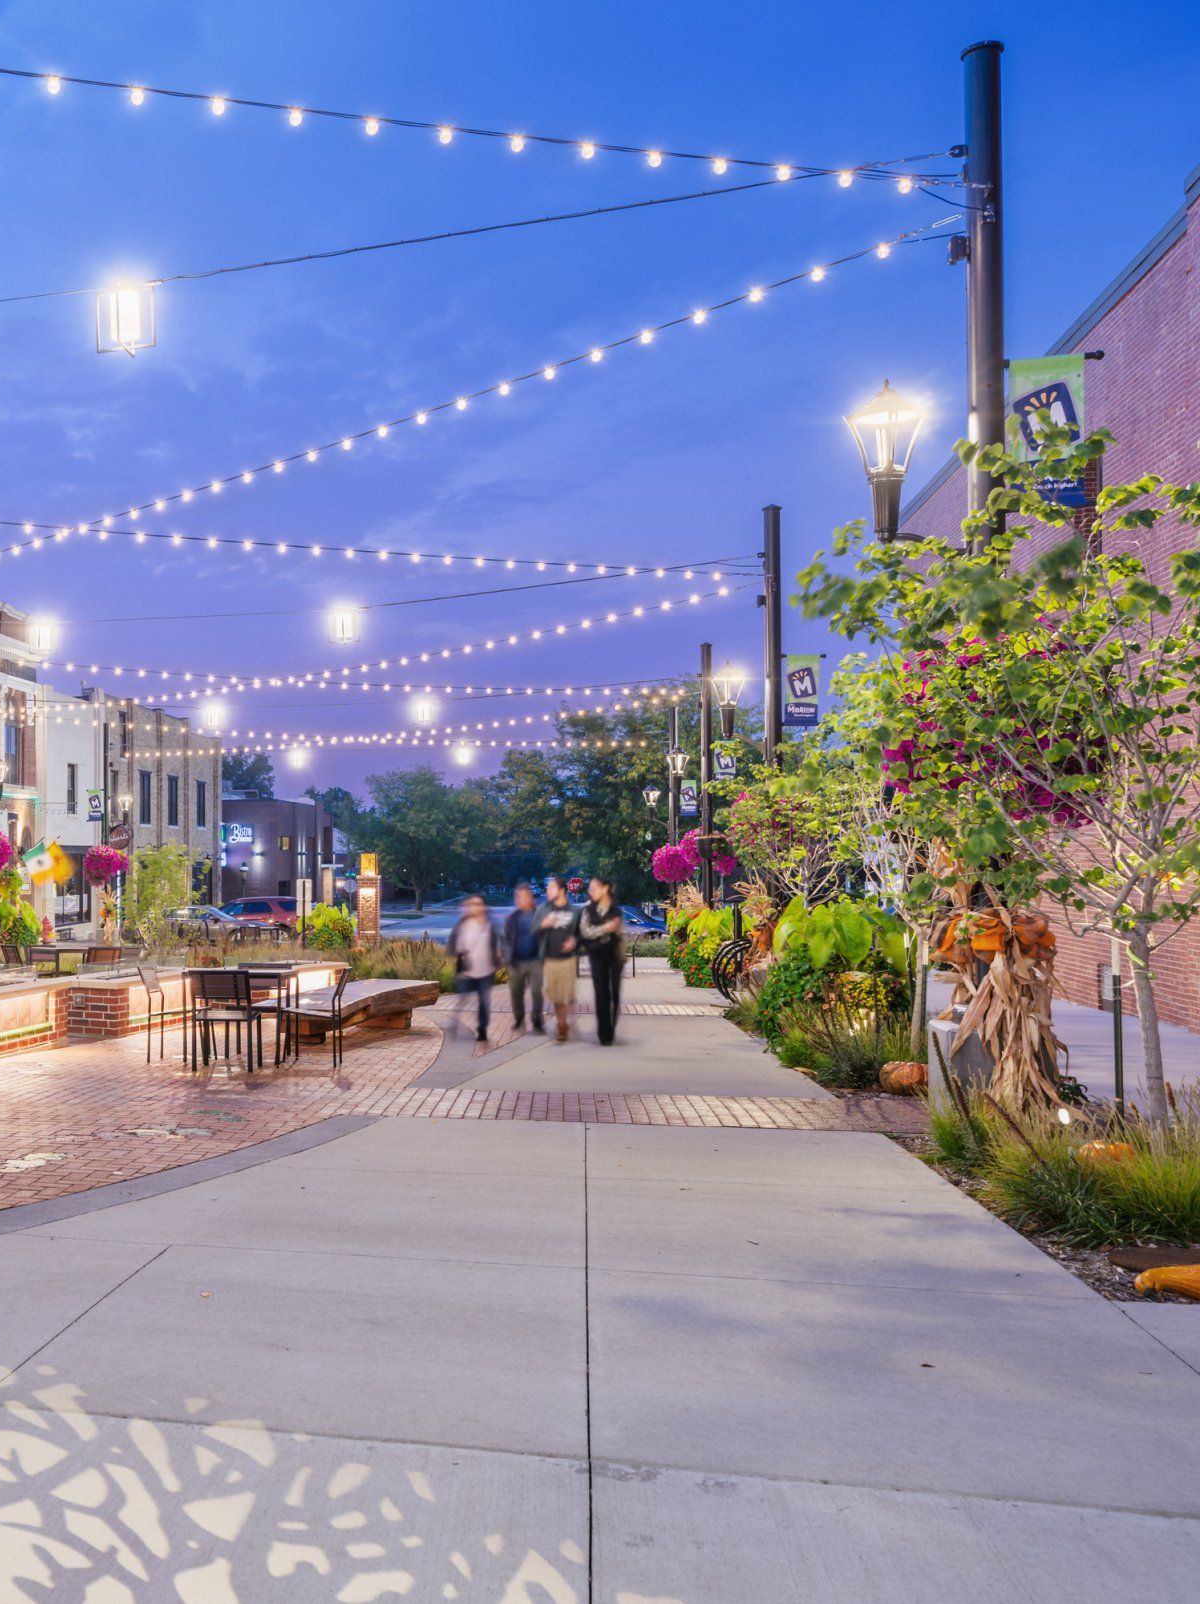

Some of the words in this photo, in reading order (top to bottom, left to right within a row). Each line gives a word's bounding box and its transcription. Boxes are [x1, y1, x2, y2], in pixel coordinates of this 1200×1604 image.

[793, 676, 813, 696] M
[719, 757, 732, 769] M
[91, 798, 100, 808] M
[230, 824, 253, 843] Bistro
